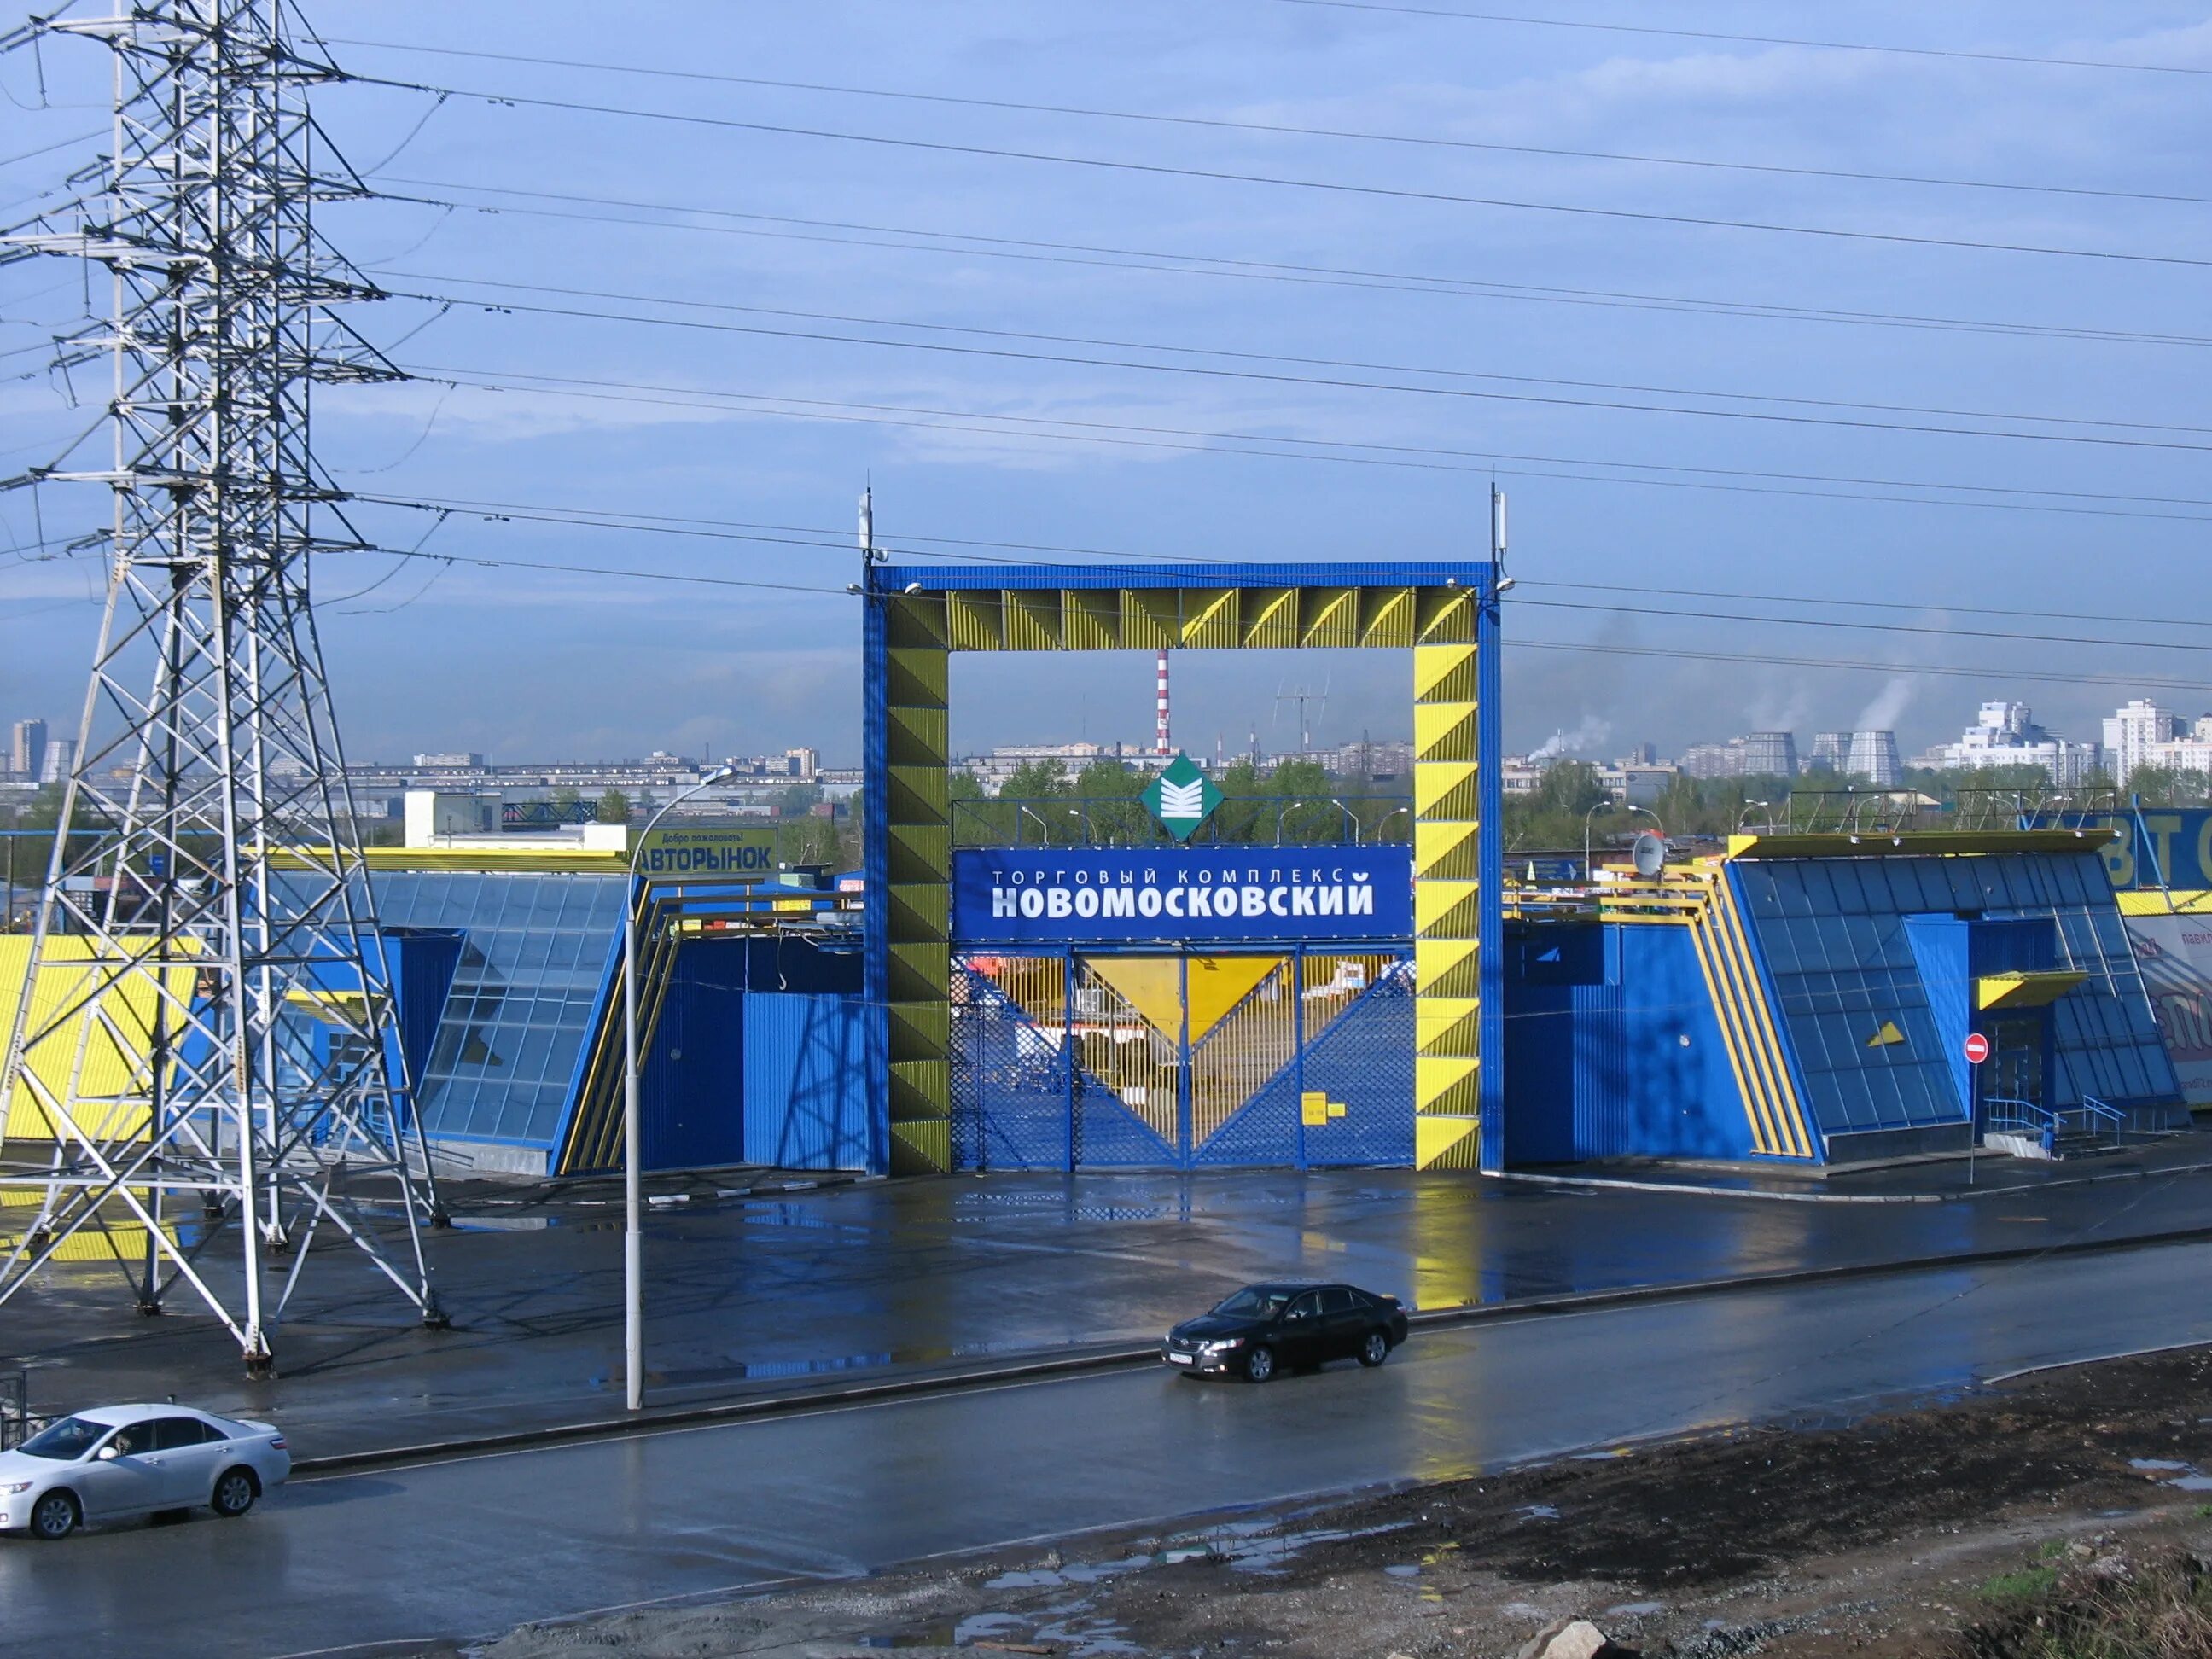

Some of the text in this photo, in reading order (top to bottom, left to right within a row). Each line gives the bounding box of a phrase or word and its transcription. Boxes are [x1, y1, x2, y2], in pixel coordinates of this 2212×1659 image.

[662, 833, 743, 845] Добро пожаловать!
[992, 868, 1343, 885] ТОРГОВЫЙ КОМПЛЕКС
[992, 872, 1373, 917] НОВОМОСКОВСКИЙ
